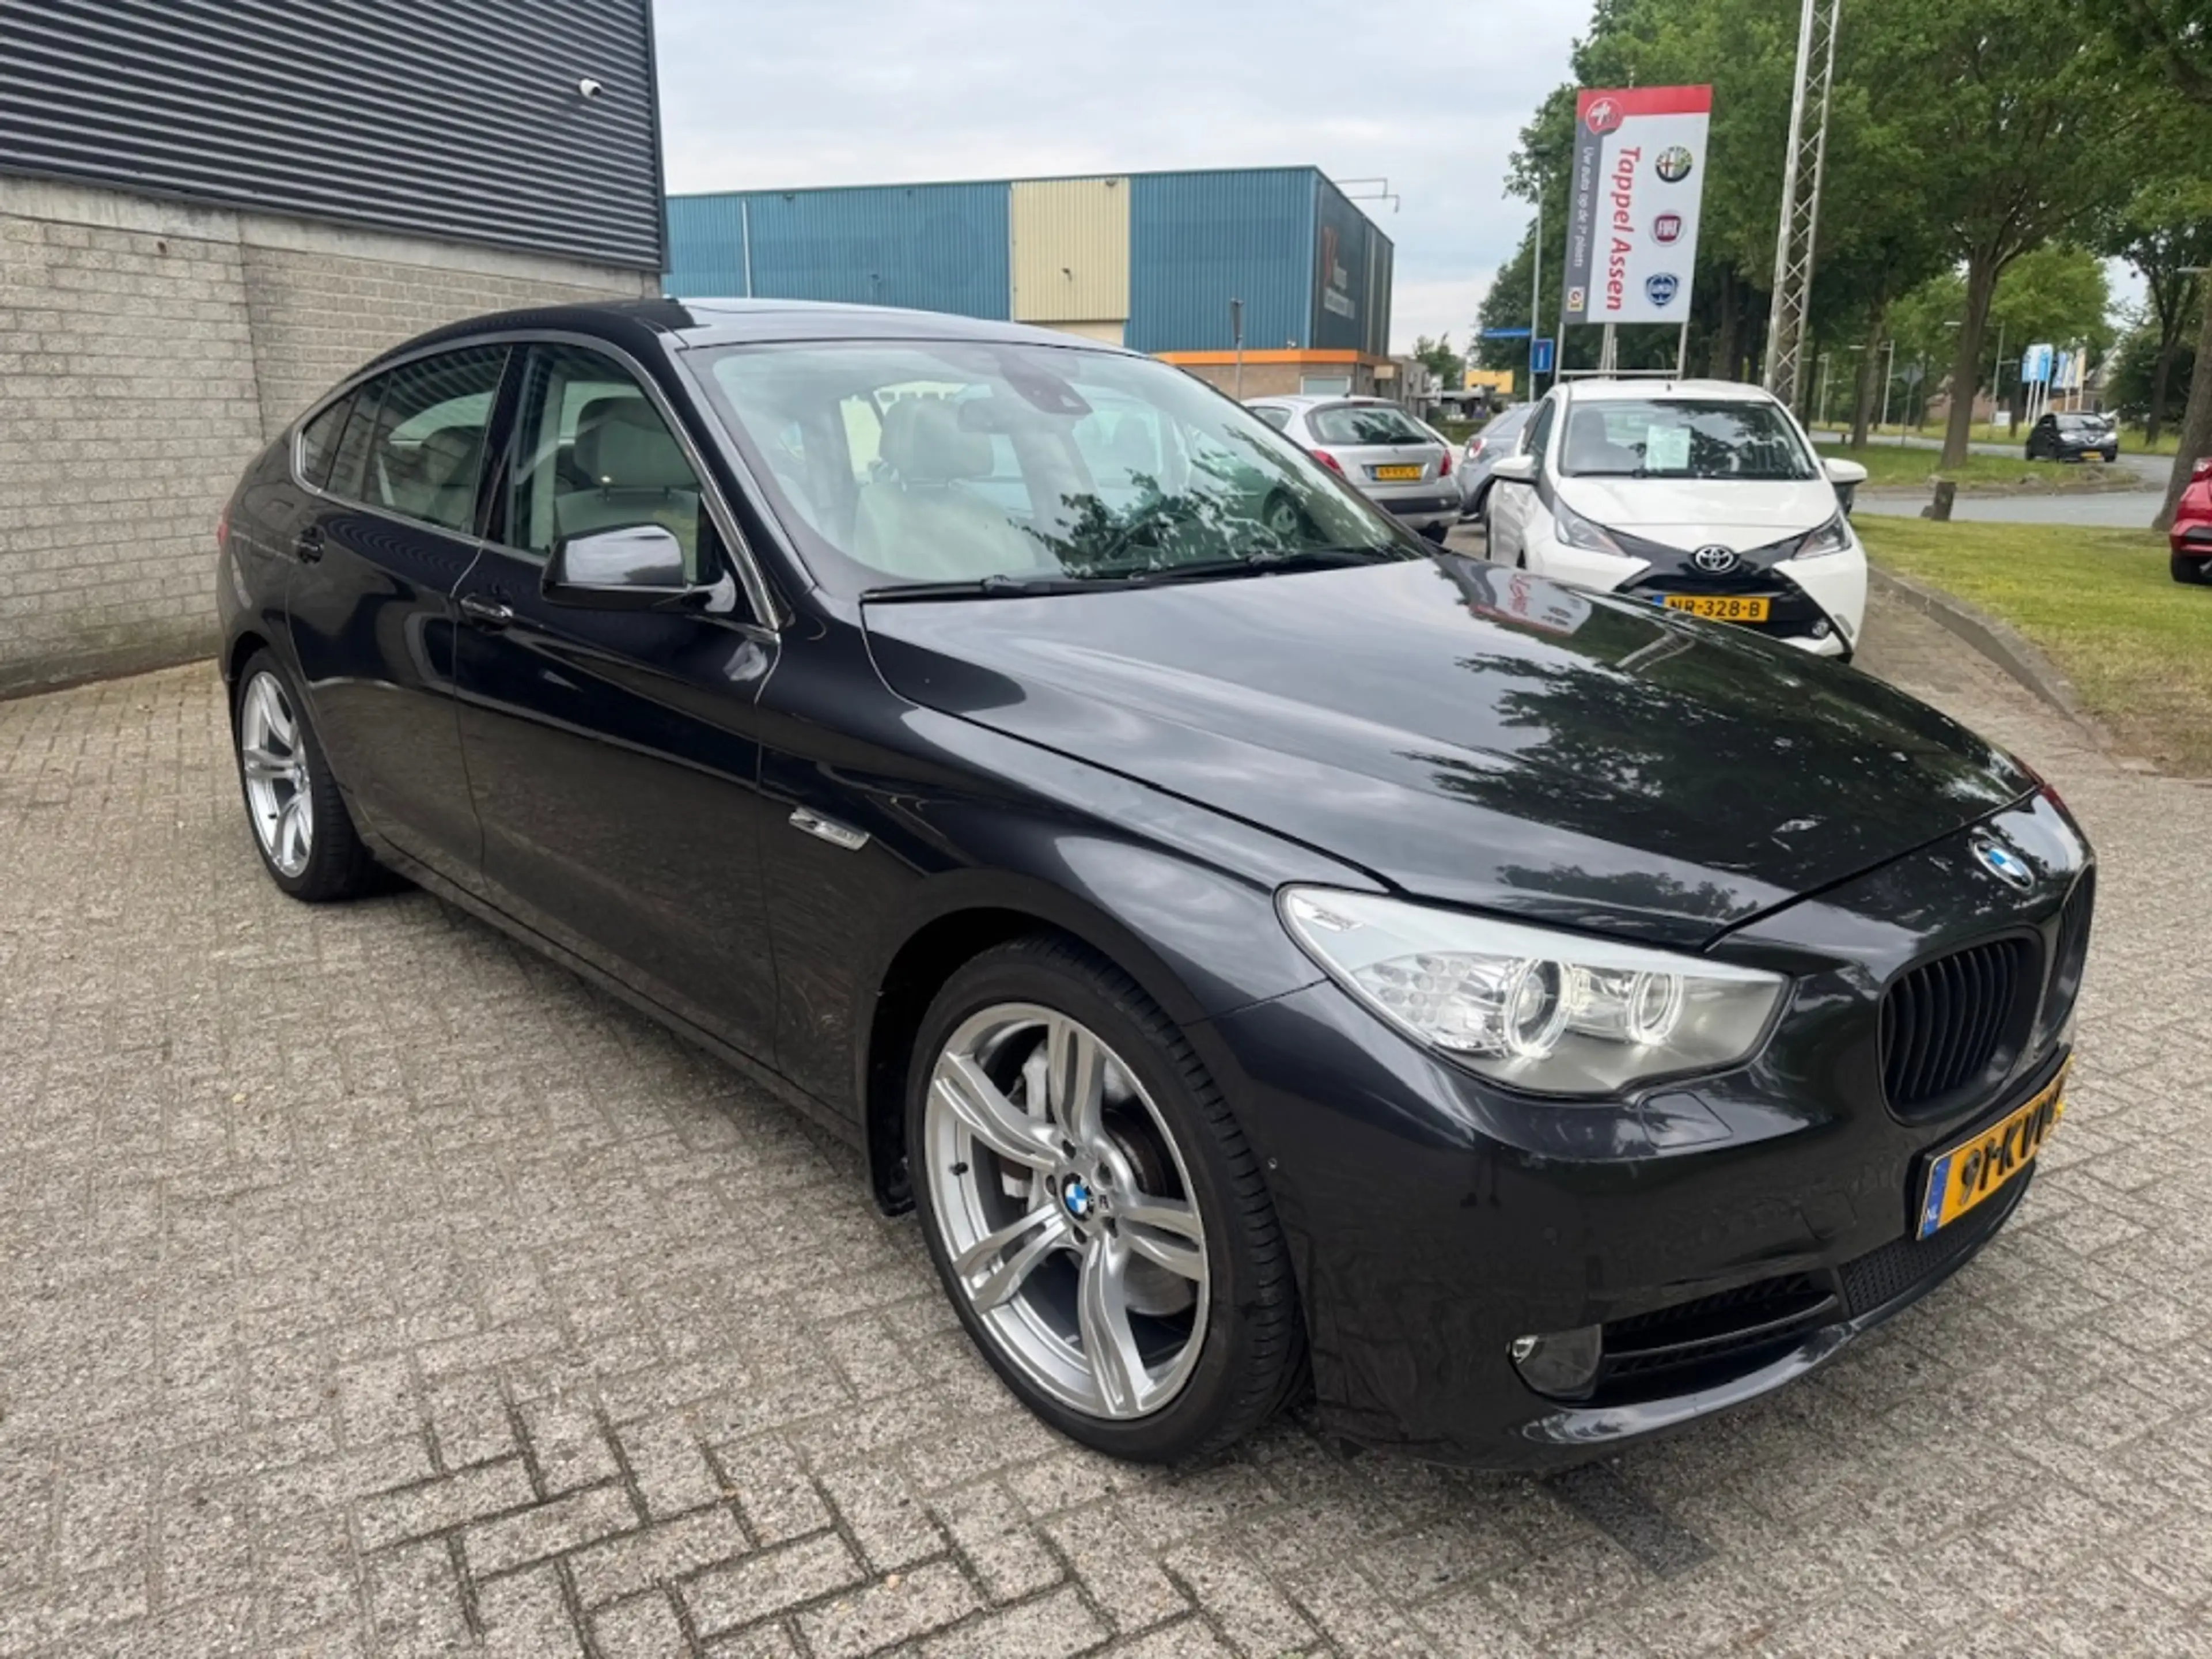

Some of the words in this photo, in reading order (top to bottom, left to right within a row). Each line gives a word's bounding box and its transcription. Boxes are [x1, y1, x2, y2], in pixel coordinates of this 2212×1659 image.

[1577, 192, 1588, 208] op
[1580, 166, 1591, 191] auto
[1611, 146, 1641, 233] Tappel
[1607, 237, 1632, 310] Assen
